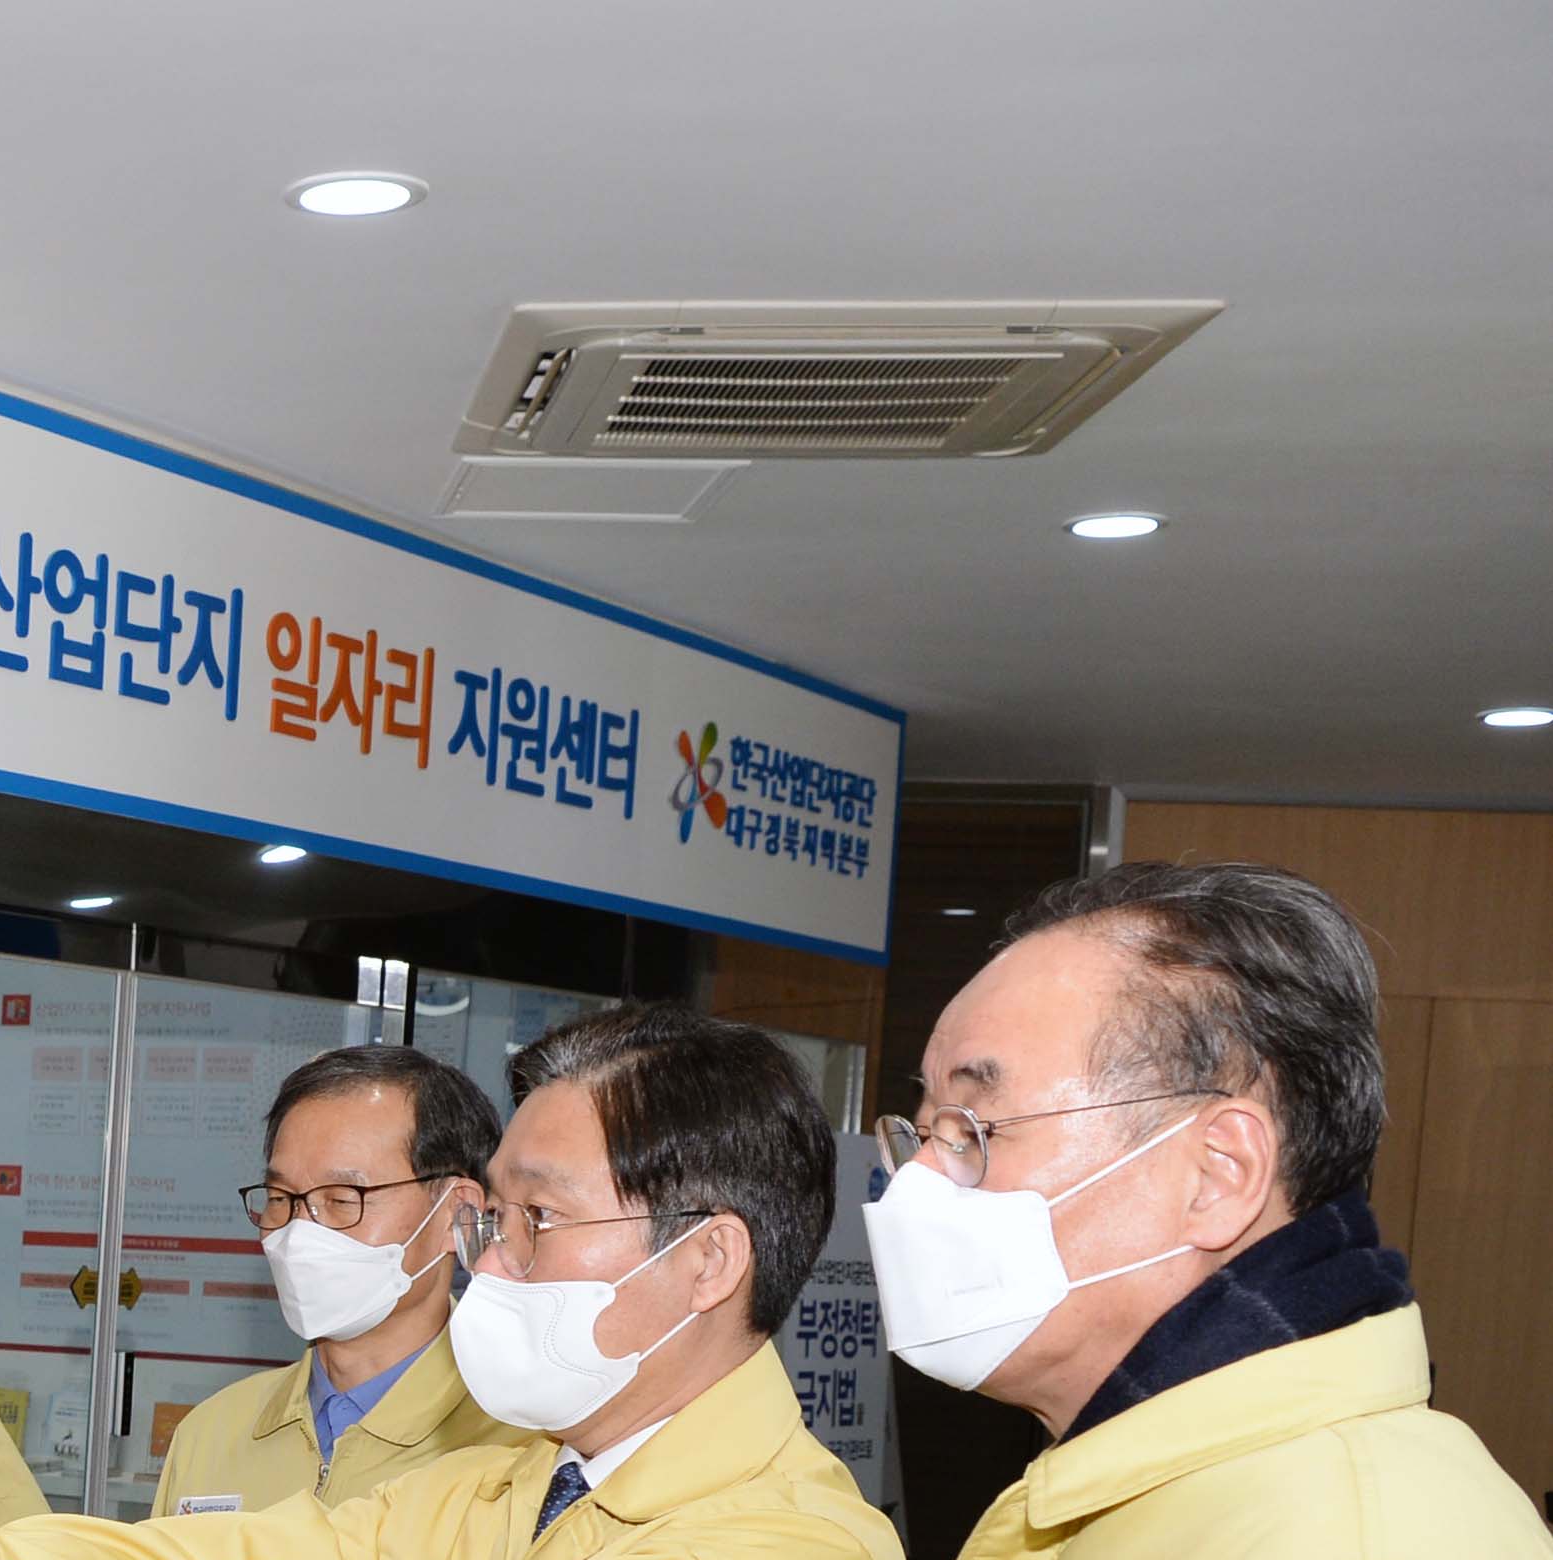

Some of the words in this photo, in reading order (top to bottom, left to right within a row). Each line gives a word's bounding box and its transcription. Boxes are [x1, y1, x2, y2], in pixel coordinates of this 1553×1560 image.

[266, 611, 436, 770] 일자리
[447, 667, 640, 820] 지원센터
[730, 736, 877, 828] 한국산업단지공단
[726, 805, 869, 880] 대구경북지역본부
[797, 1298, 879, 1358] 부정청탁
